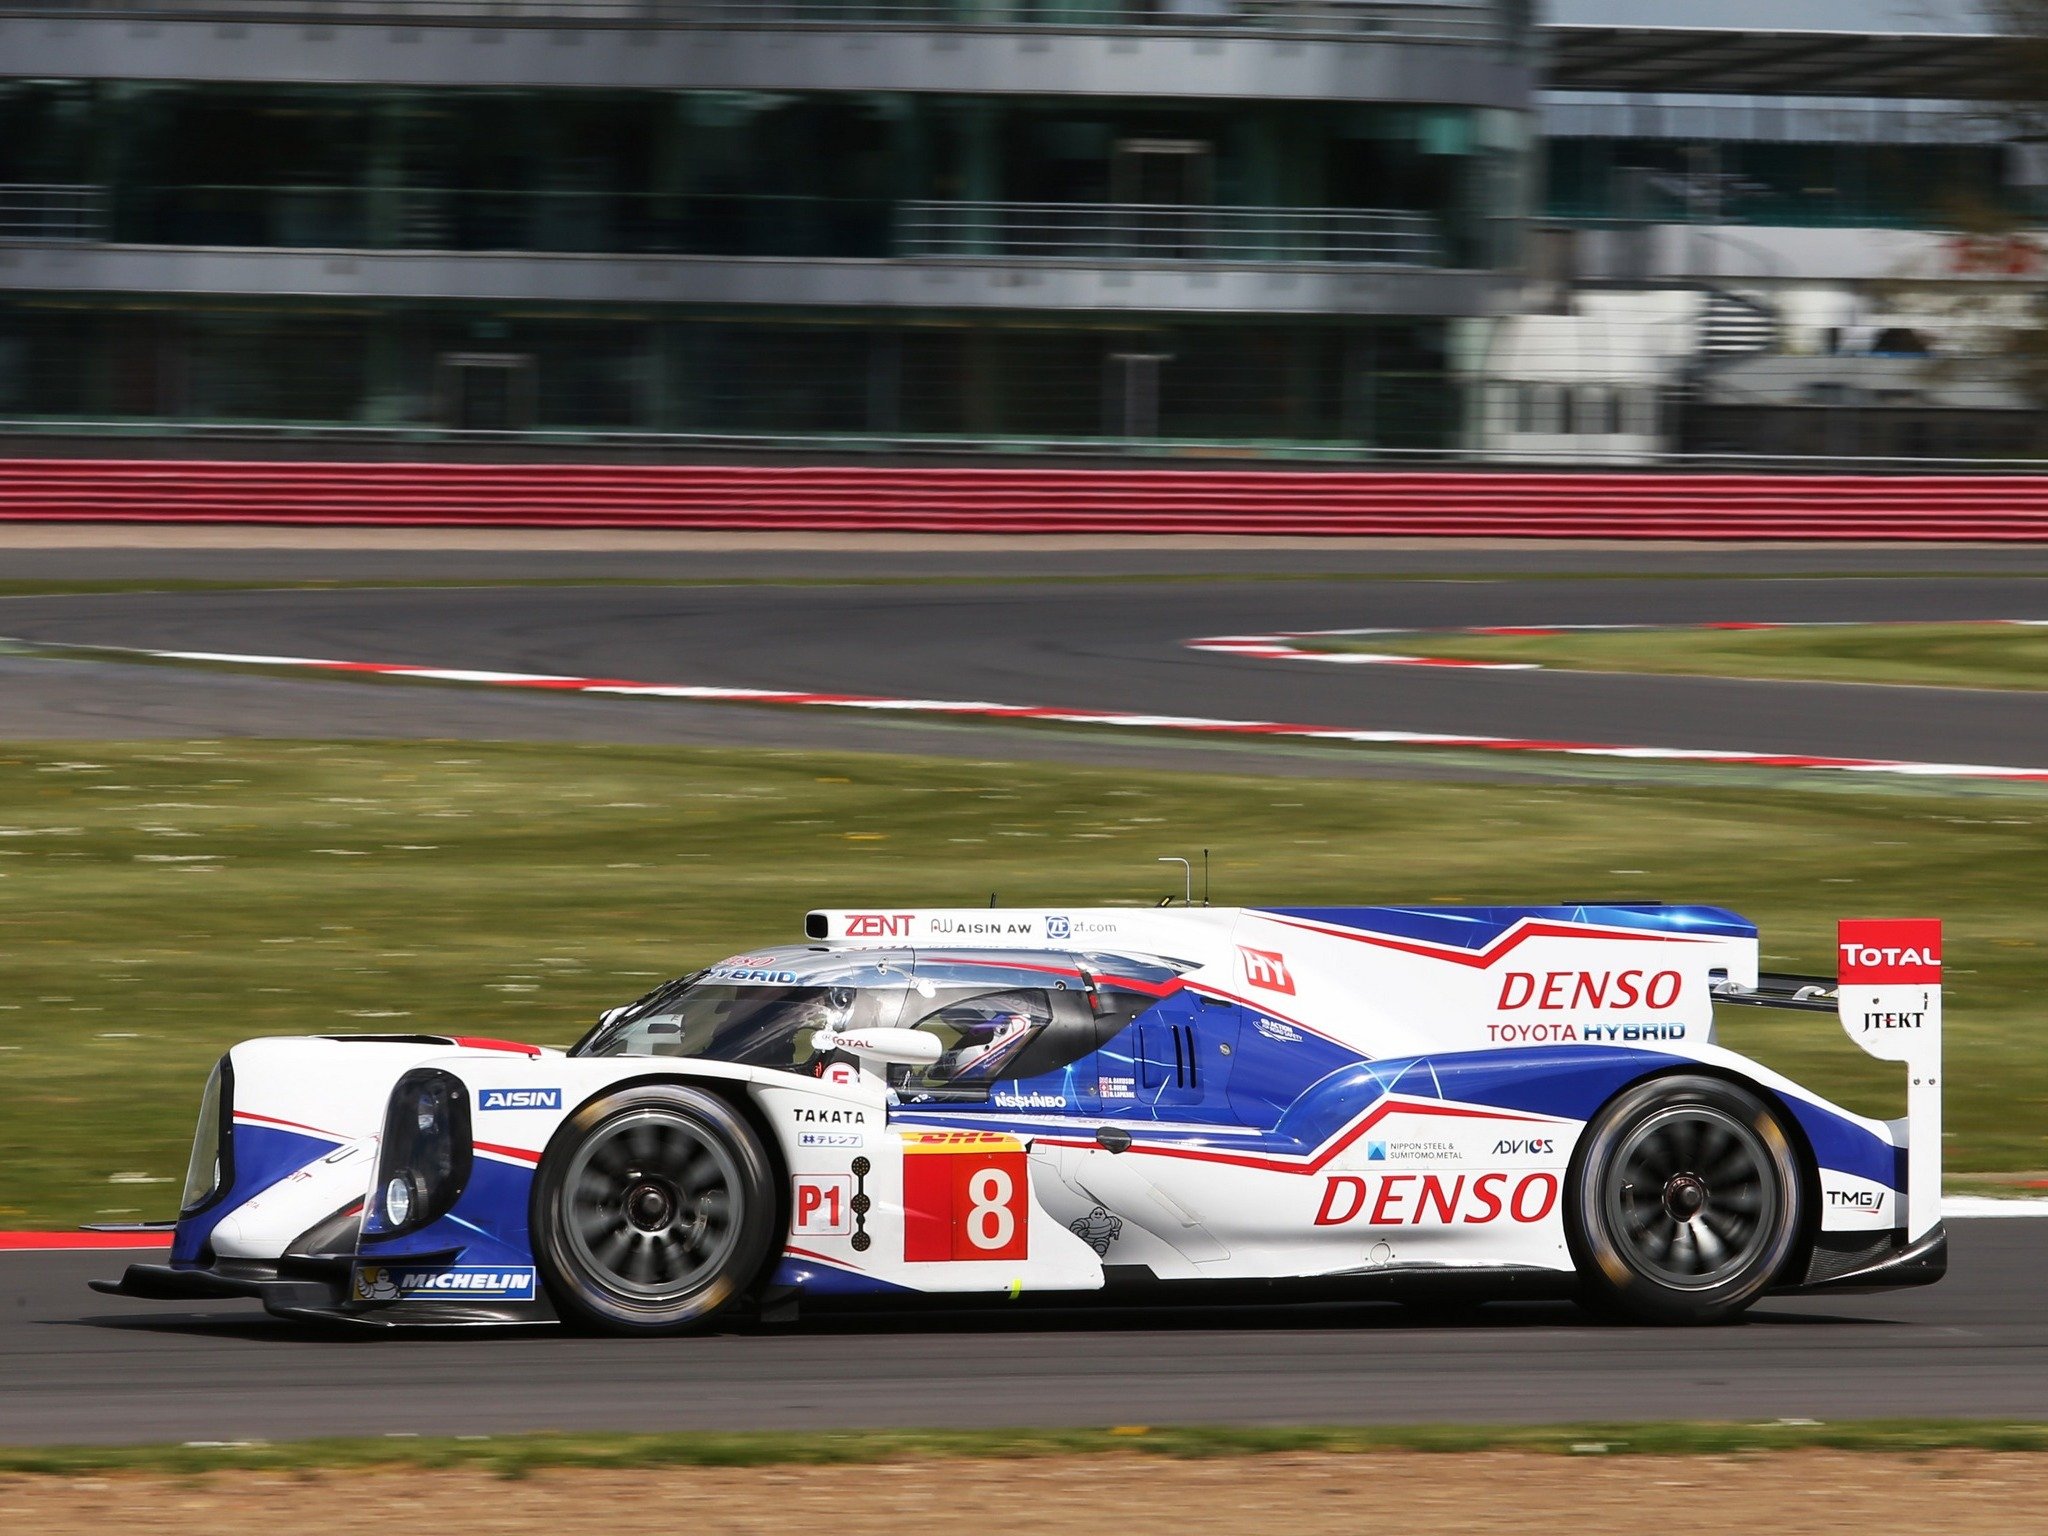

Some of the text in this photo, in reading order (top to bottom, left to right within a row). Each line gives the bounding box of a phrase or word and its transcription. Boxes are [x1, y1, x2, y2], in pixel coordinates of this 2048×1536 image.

[845, 915, 915, 937] ZENT
[956, 924, 1001, 934] AISIN
[1007, 924, 1032, 934] AW
[1049, 919, 1068, 937] ZF
[1073, 922, 1117, 932] zf.com
[1840, 943, 1942, 967] TOTAL
[1497, 970, 1682, 1010] DENSO
[1863, 1012, 1924, 1032] JTEKT
[1487, 1023, 1686, 1041] TOYOTA HYBRID
[484, 1092, 555, 1107] AISIN
[793, 1109, 865, 1124] TAKATA
[1390, 1142, 1454, 1150] NIPPON STEEL &
[1390, 1151, 1463, 1160] SUMITOMO METAL
[797, 1185, 841, 1227] P1
[1314, 1172, 1558, 1225] DENSO
[966, 1167, 1015, 1250] 8
[401, 1272, 532, 1290] MICHELIN
